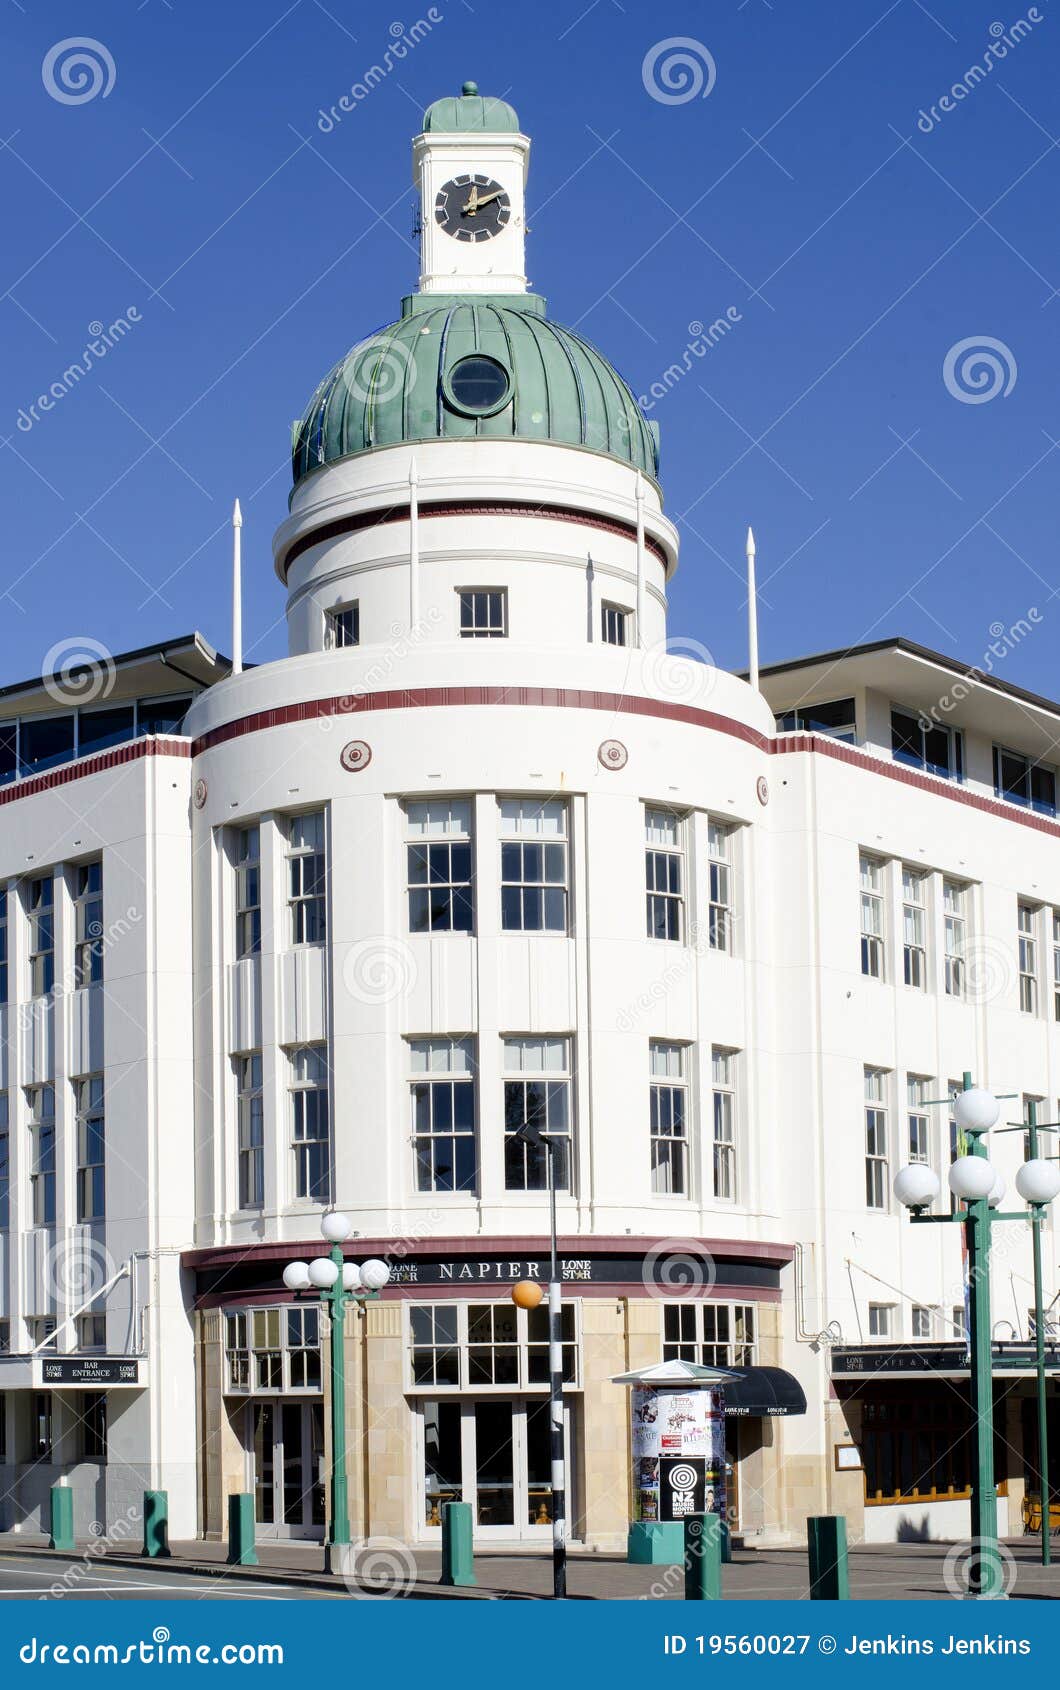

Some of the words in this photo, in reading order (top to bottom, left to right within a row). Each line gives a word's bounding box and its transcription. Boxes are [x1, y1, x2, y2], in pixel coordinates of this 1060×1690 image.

[561, 1260, 591, 1270] LONE
[439, 1262, 540, 1279] NAPIER
[84, 1361, 98, 1369] BAR
[72, 1369, 111, 1377] ENTRANCE
[672, 1491, 695, 1502] NZ
